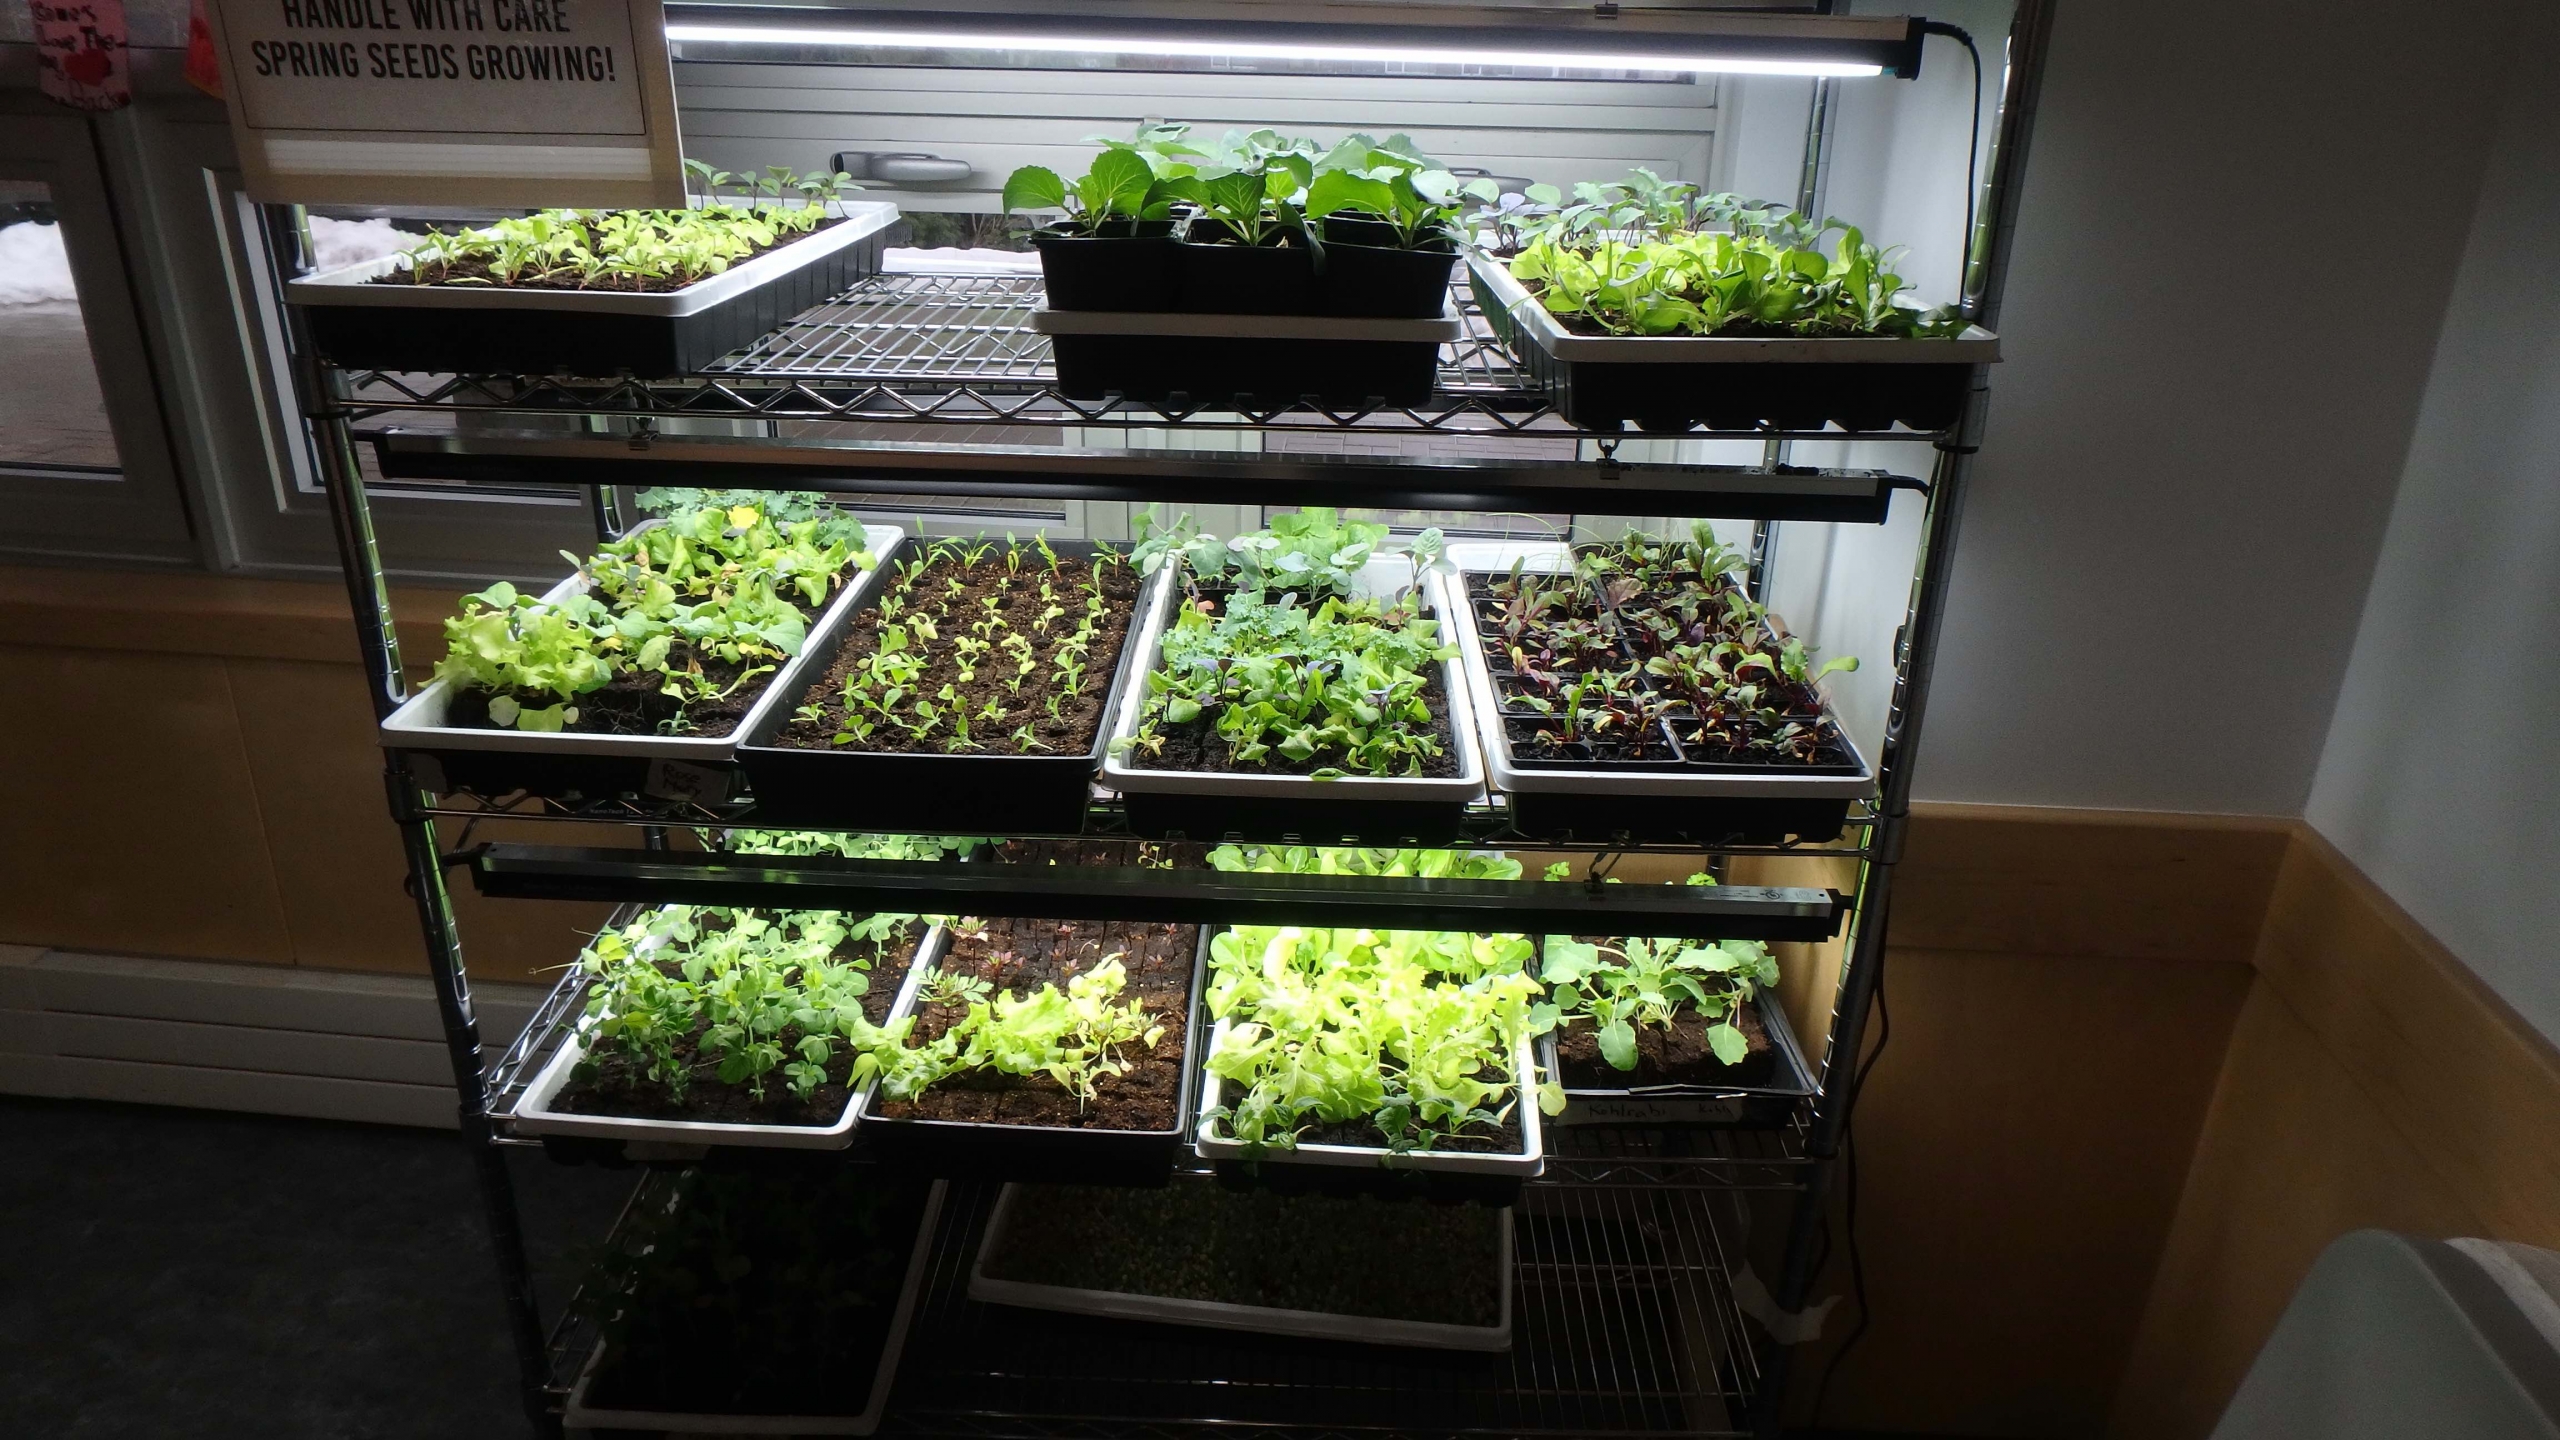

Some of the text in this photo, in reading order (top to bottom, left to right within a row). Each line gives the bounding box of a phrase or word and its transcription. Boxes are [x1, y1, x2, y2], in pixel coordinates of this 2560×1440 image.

[284, 0, 571, 34] HANDLE WITH CARE
[251, 40, 616, 82] SPRING SEEDS GROWING!
[662, 763, 701, 783] Rose
[1588, 1103, 1667, 1119] Kohlrabi
